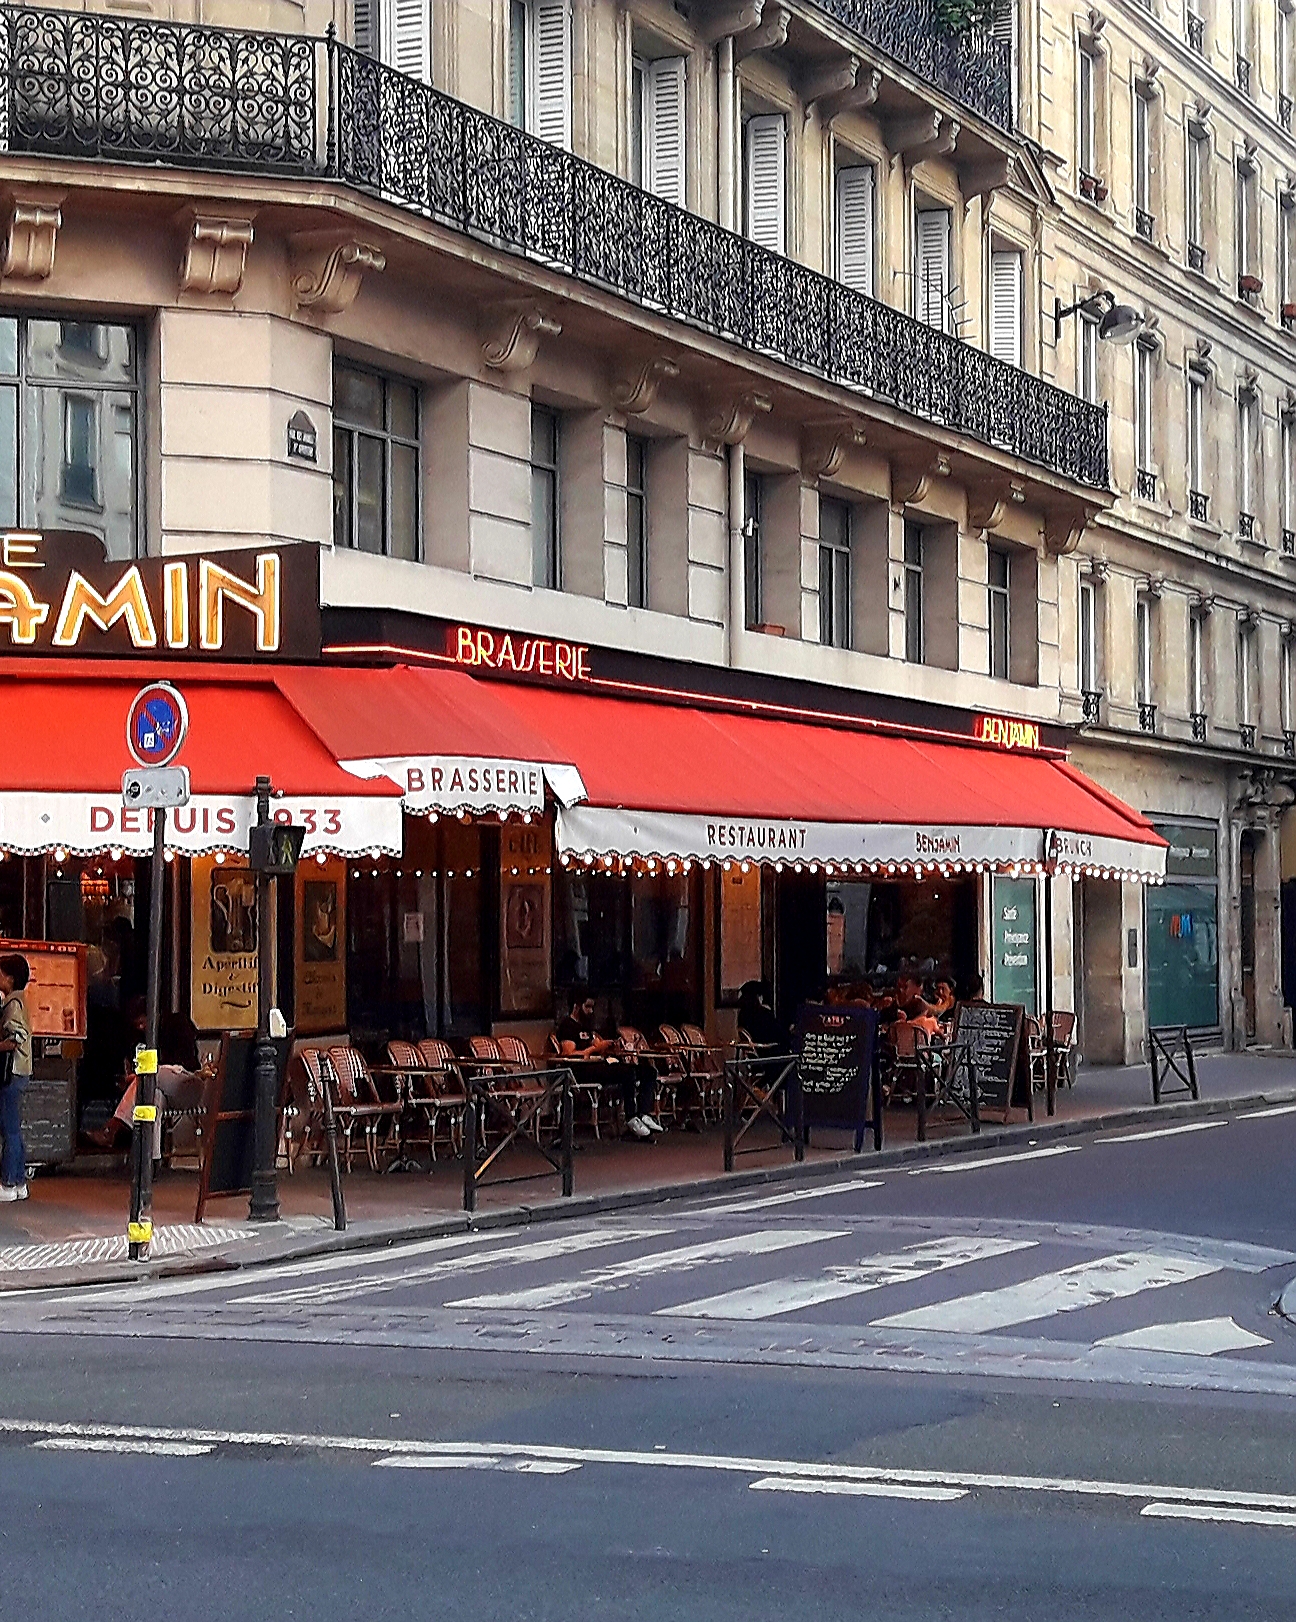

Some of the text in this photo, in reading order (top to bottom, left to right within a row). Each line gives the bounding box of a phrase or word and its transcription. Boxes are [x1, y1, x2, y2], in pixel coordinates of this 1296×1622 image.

[455, 626, 592, 681] BRASSERIE
[981, 716, 1040, 751] BENJAMIN
[406, 767, 539, 796] BRASSERIE
[706, 824, 807, 849] RESTAURANT
[915, 831, 961, 854] BENJAMIN
